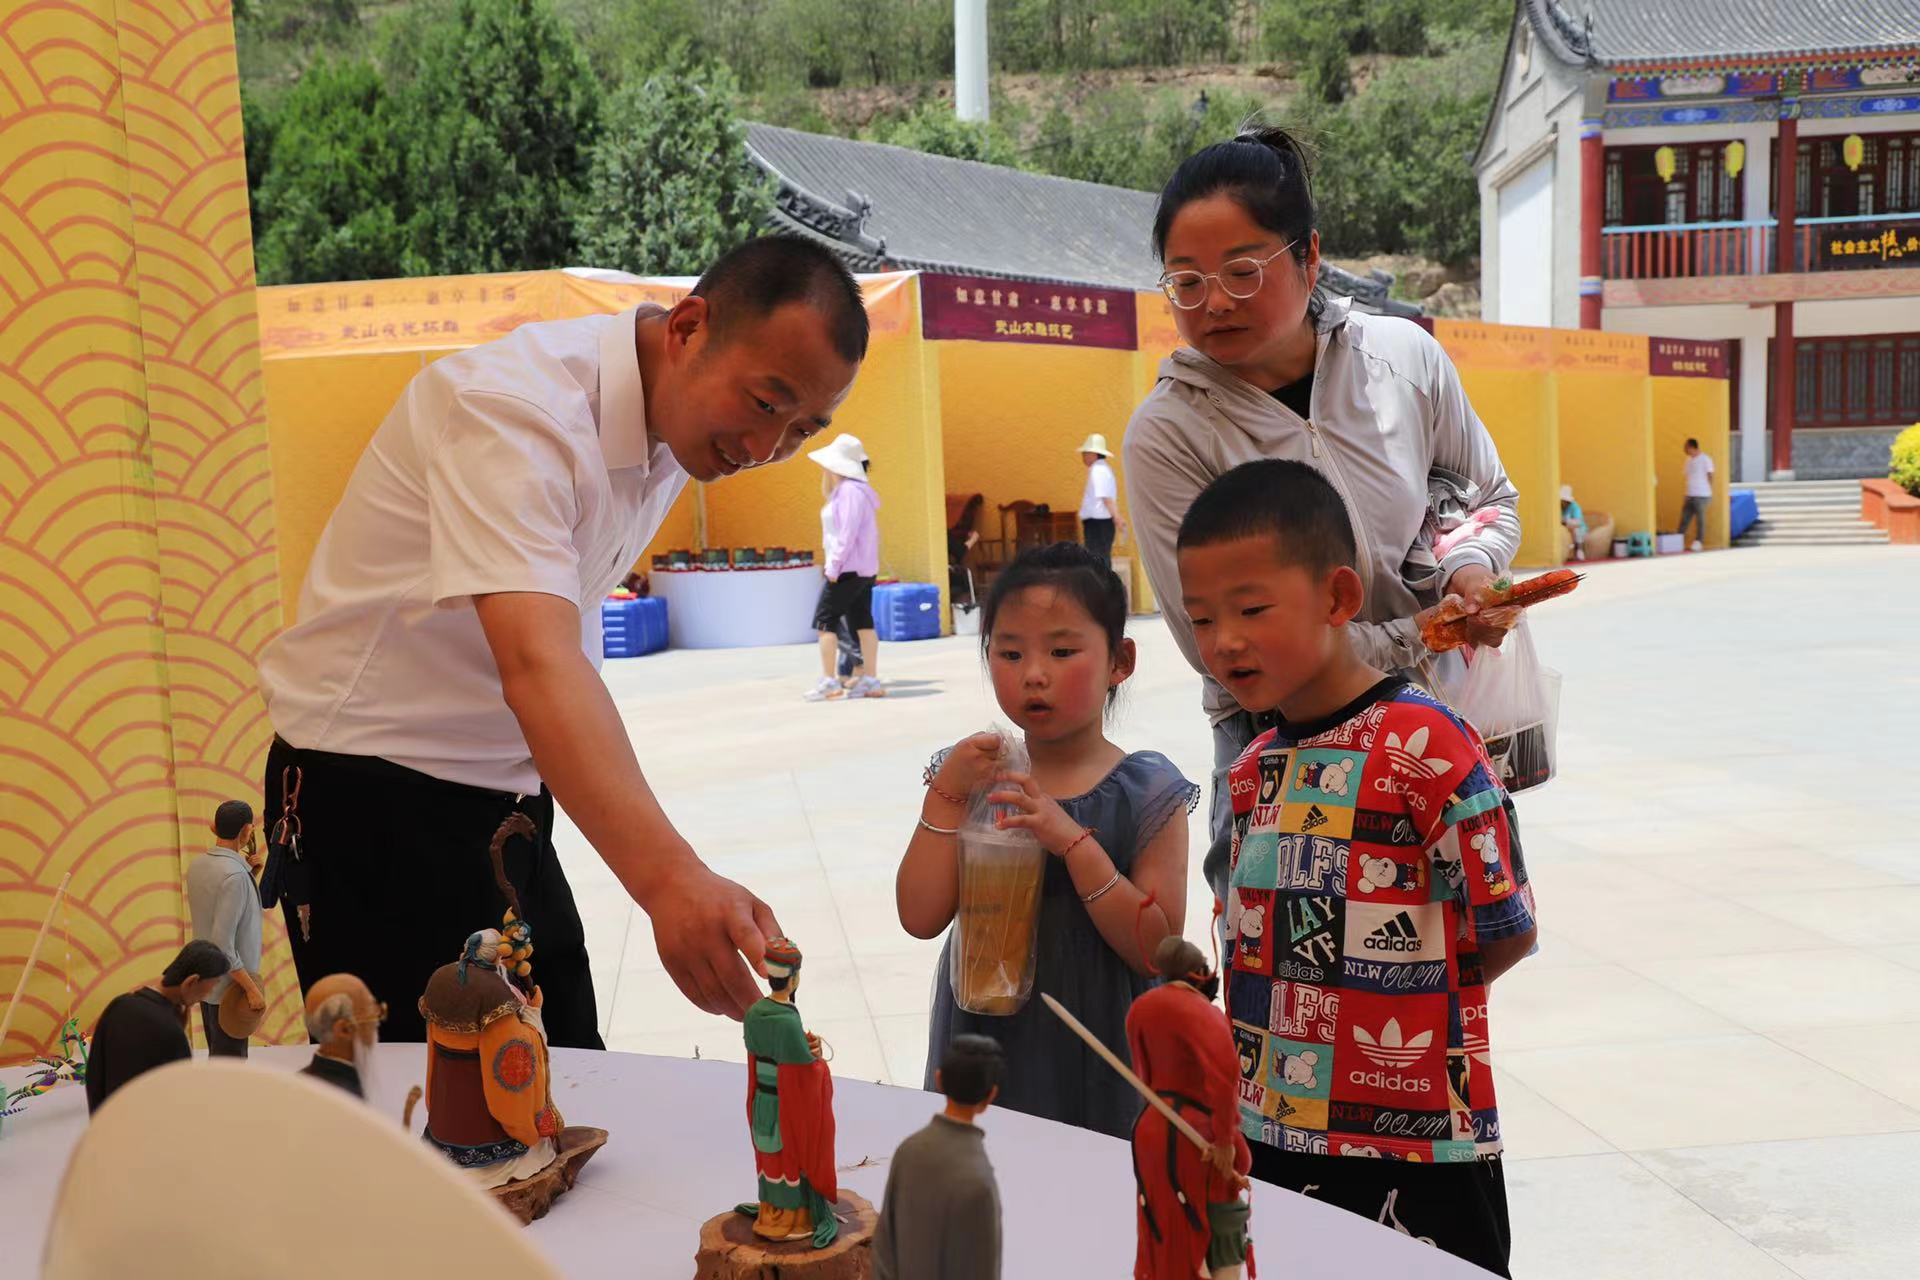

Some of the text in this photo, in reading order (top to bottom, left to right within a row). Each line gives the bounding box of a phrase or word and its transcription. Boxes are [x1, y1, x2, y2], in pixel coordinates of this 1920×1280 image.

[1300, 815, 1329, 833] adidas
[1363, 936, 1423, 952] adidas
[1343, 961, 1381, 981] NLW
[1349, 1071, 1432, 1093] adidas
[1331, 1103, 1374, 1123] NLW
